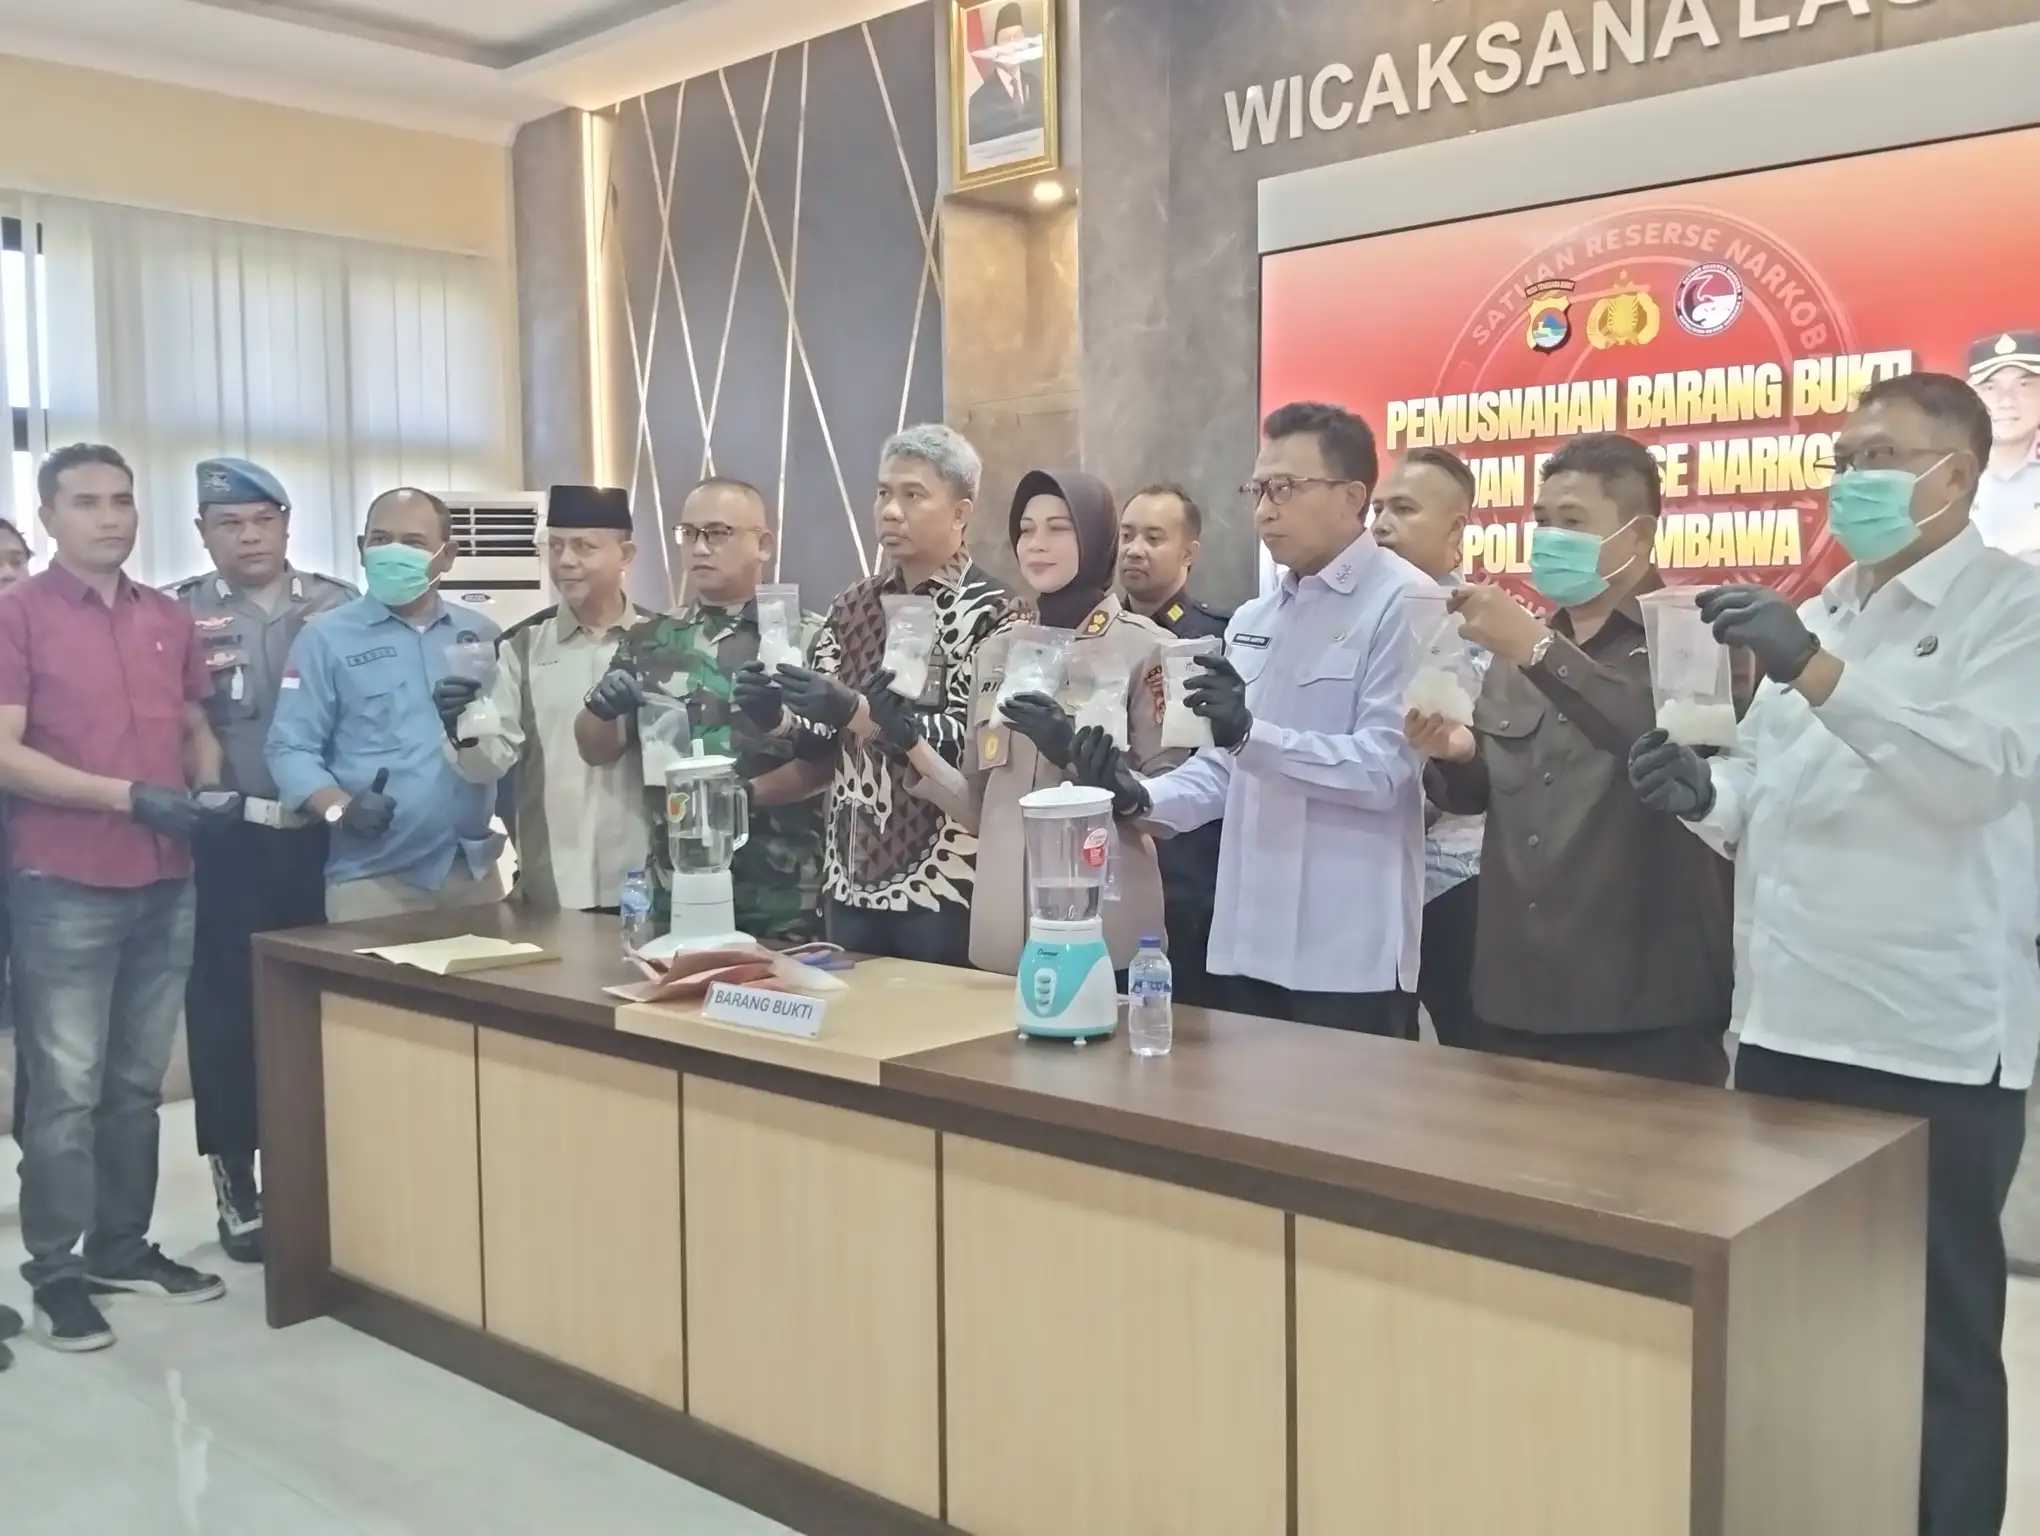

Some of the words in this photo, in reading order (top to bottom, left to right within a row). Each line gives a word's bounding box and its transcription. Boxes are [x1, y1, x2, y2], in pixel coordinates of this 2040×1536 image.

[1223, 0, 1721, 151] WICAKSANA
[1585, 222, 1721, 257] RESERSE
[1723, 238, 1833, 356] NARKOB
[1386, 378, 1618, 450] PEMUSNAHAN
[1626, 362, 1783, 430] BARANG
[1697, 431, 1843, 496] NARKO
[1649, 508, 1802, 568] MBAWA
[980, 681, 1004, 693] RI
[714, 989, 771, 1012] BARANG
[772, 999, 814, 1021] BUKTI
